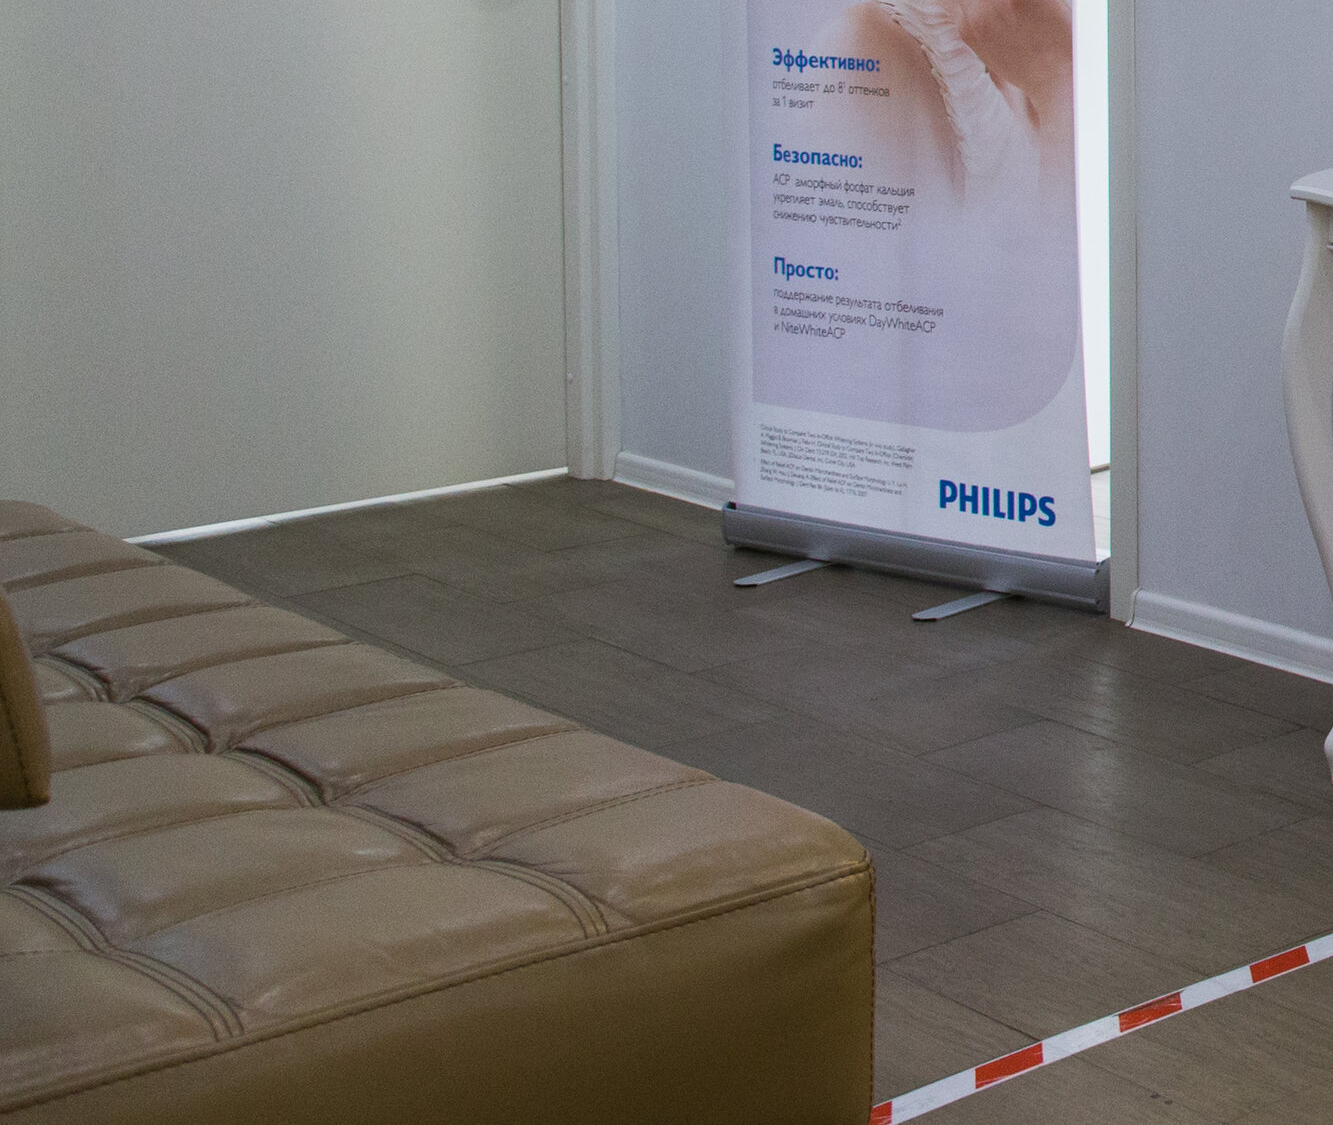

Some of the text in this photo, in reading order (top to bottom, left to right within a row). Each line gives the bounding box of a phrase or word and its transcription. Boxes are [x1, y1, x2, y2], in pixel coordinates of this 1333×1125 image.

[773, 48, 880, 73] Эффективно:
[773, 78, 821, 92] отбеливает
[824, 85, 835, 94] до
[849, 86, 891, 97] оттенков
[789, 99, 815, 109] визит
[773, 144, 863, 169] Безопасно:
[795, 178, 842, 193] аморфный
[844, 180, 875, 195] фосфат
[877, 186, 915, 197] кальция
[773, 194, 816, 208] укрепляет
[848, 200, 910, 217] способствует
[774, 210, 817, 223] снижению
[774, 257, 839, 282] Просто:
[774, 289, 945, 317] поддержание результата отбеливания
[780, 307, 827, 320] домашних
[830, 312, 867, 326] условиях
[869, 314, 936, 334] DayWhiteACP
[781, 321, 846, 340] NiteWhiteACP
[939, 479, 1056, 528] PHILIPS
